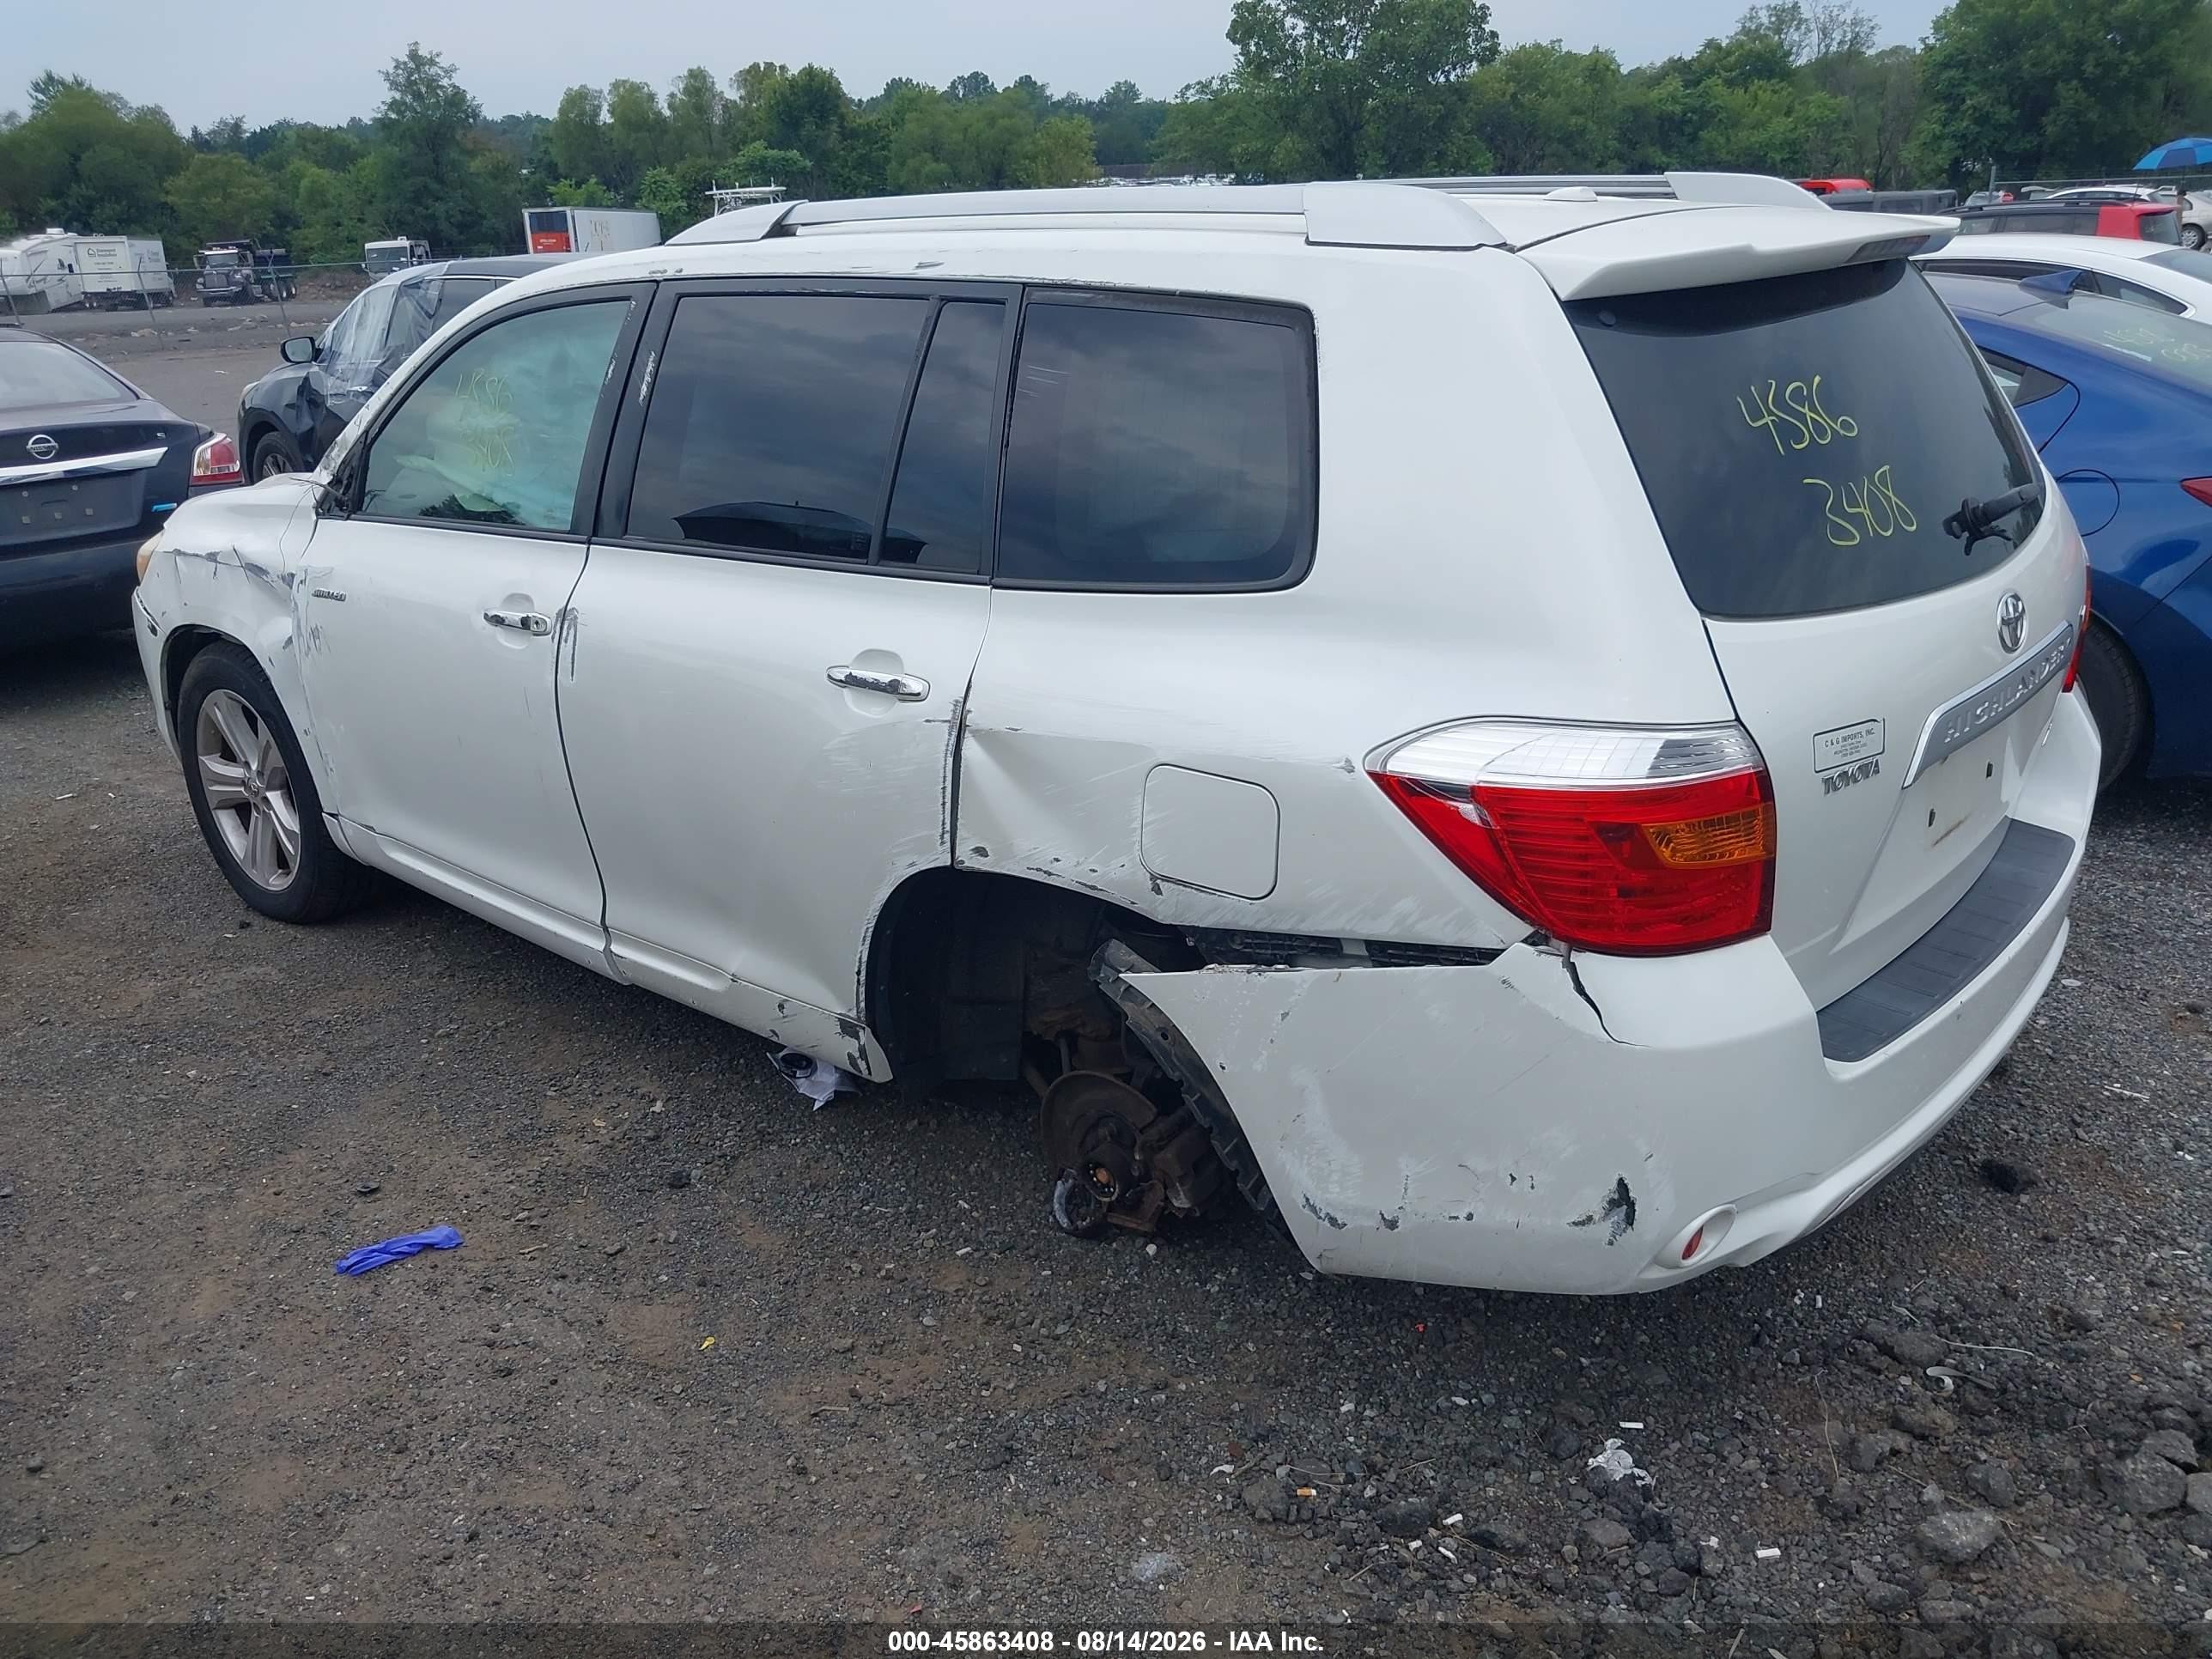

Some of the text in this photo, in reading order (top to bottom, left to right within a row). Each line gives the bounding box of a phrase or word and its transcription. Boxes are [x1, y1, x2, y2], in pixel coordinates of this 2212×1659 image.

[1736, 374, 1859, 456] 4586
[1802, 464, 1917, 547] 3408
[1943, 637, 2071, 744] HIGHLANDER
[1820, 756, 1881, 795] TOYOTA
